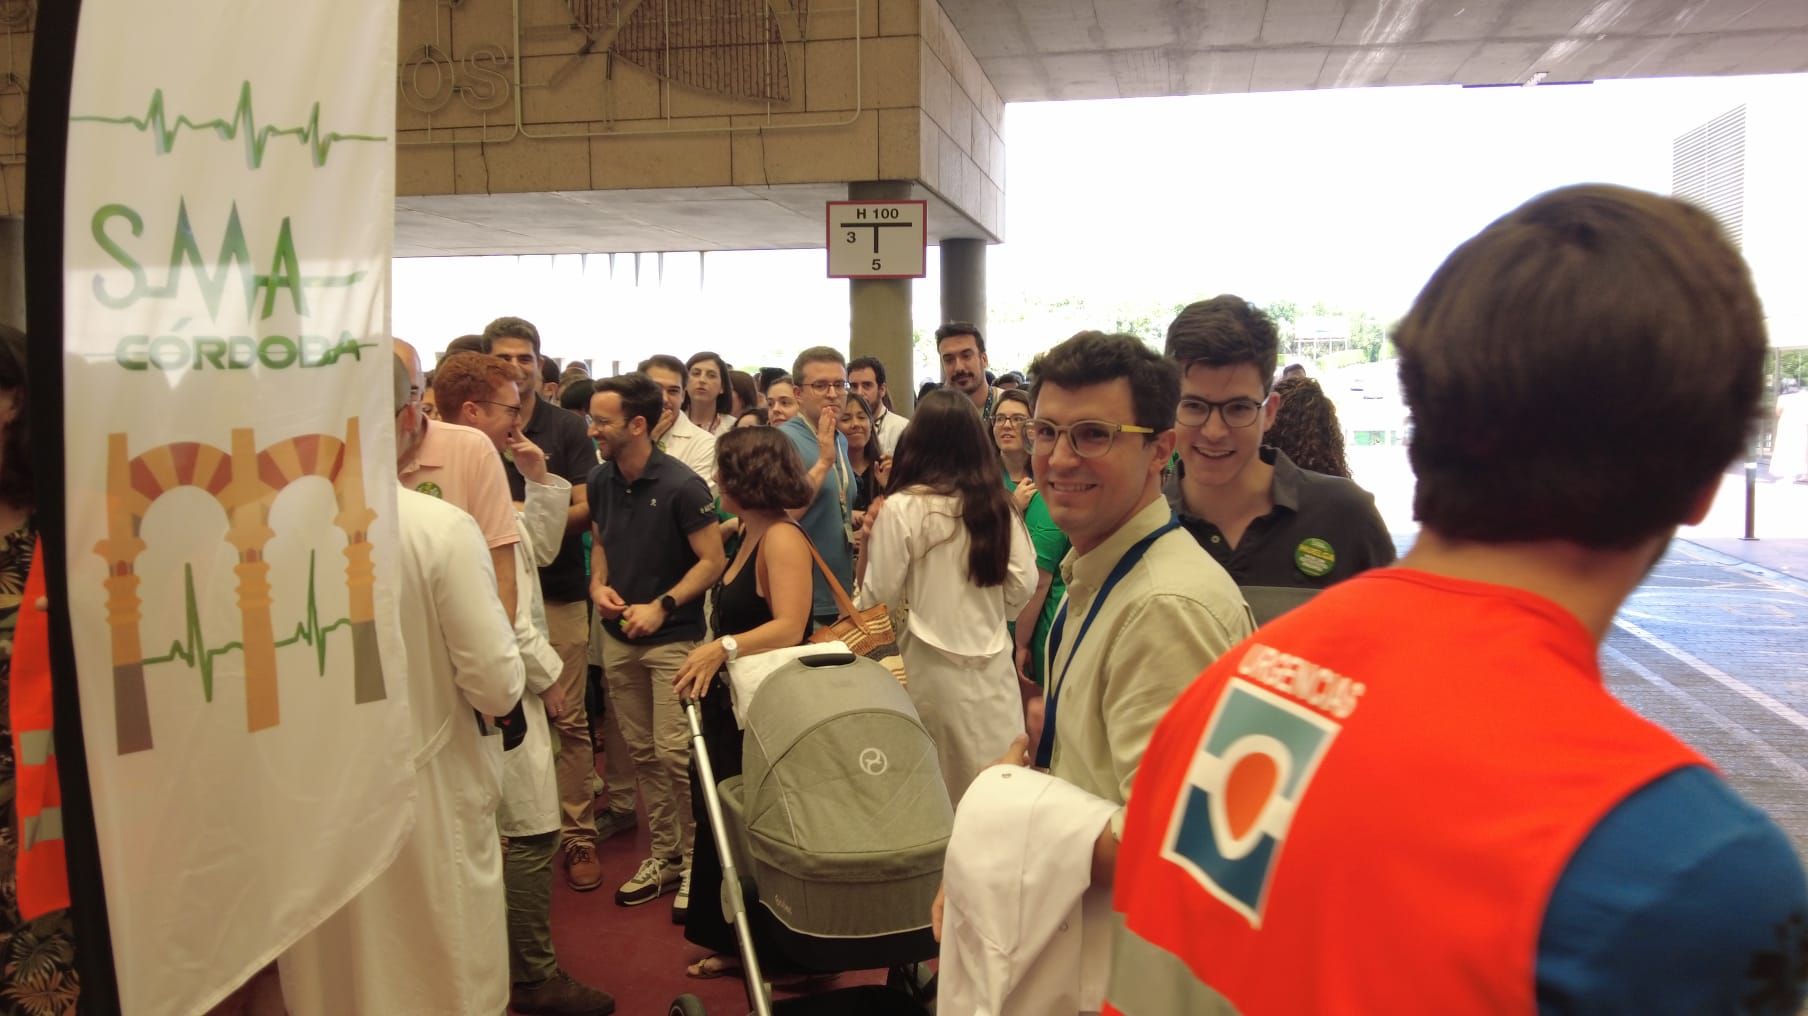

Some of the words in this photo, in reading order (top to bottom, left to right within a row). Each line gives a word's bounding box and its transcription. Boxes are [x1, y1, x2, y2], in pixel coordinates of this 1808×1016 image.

[856, 208, 867, 219] H
[872, 208, 899, 219] 100
[846, 231, 857, 244] 3
[91, 194, 366, 324] SMA
[871, 258, 882, 271] 5
[115, 317, 376, 371] CÓRDOBA
[1237, 642, 1366, 719] URGENCIAS
